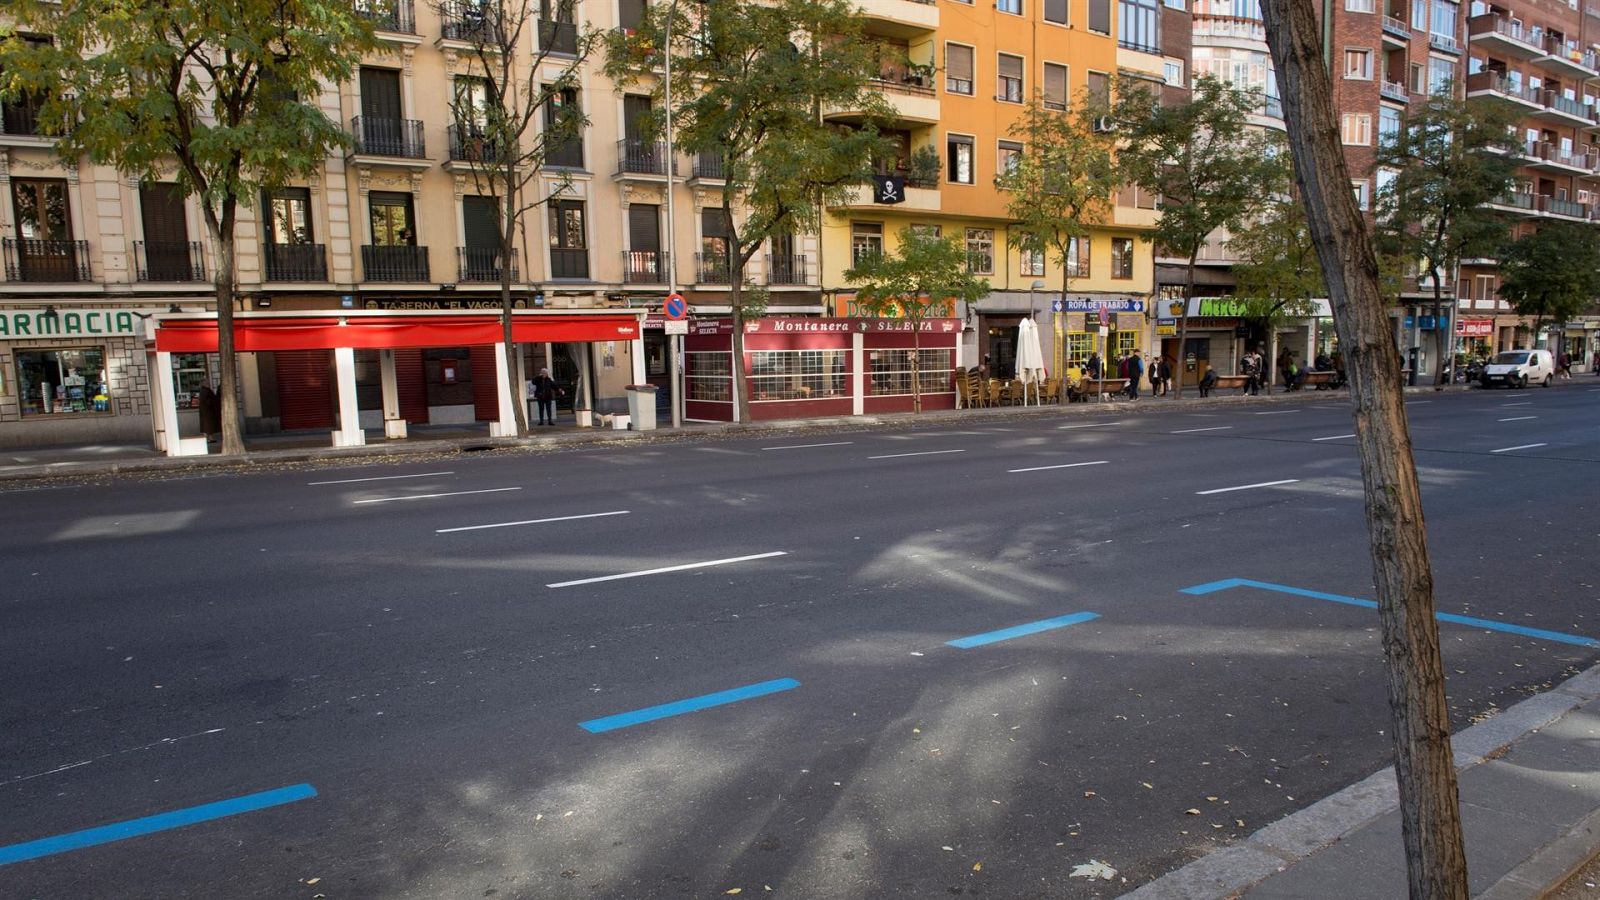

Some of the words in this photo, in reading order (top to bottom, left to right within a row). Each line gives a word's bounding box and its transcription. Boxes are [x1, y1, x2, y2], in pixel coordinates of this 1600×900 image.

[381, 301, 441, 310] TABERNA
[1099, 302, 1129, 310] TRABAJO
[774, 321, 848, 331] Montanera
